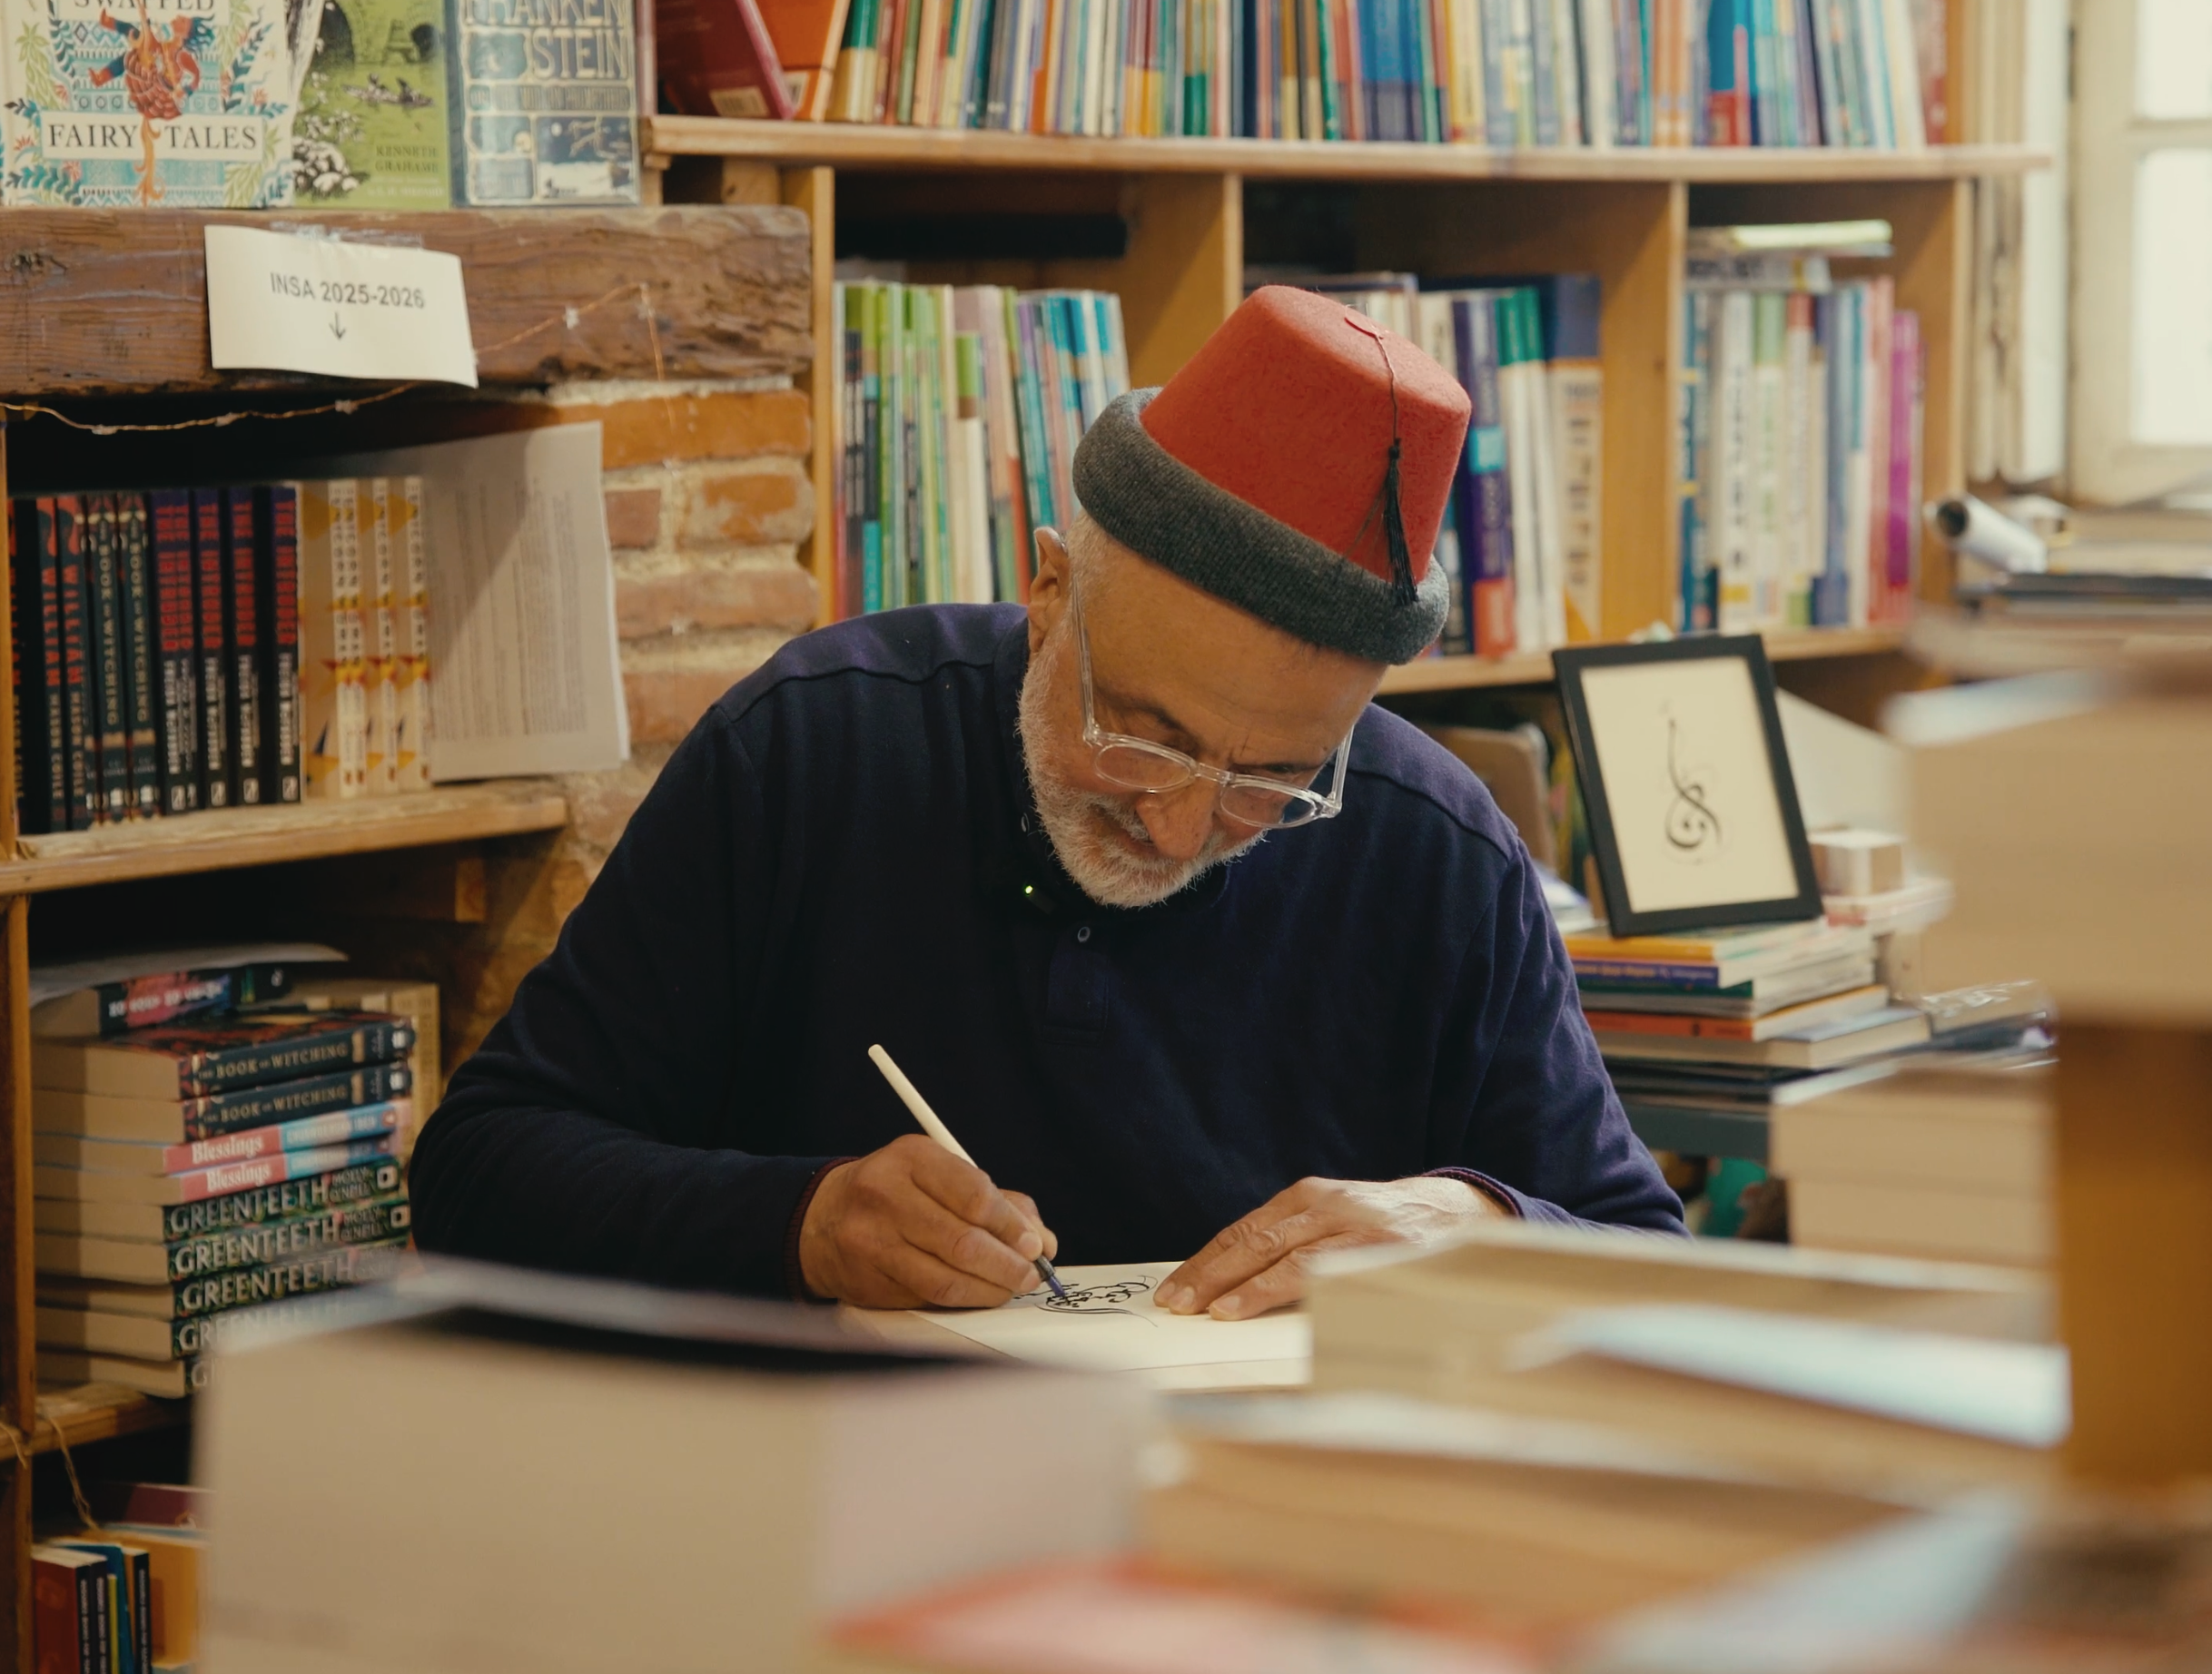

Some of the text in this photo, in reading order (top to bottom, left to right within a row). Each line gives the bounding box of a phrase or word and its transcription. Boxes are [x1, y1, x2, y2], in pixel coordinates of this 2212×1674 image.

[532, 27, 627, 79] STEIN
[48, 124, 257, 150] FAIRY TALES
[375, 145, 439, 157] KENNETH
[374, 161, 439, 173] GRAHAME
[271, 271, 425, 310] INSA 2025-2026
[155, 505, 176, 543] THE
[198, 503, 221, 542] THE
[233, 501, 253, 538] THE
[275, 500, 296, 537] THE
[98, 544, 113, 600] BOOK
[129, 542, 143, 598] BOOK
[233, 547, 257, 646] INTRUDER
[276, 547, 297, 645] INTRUDER
[63, 565, 85, 684] WILLIAM
[158, 551, 180, 652] INTRUDER
[201, 550, 223, 649] INTRUDER
[41, 566, 61, 687] WILLIAM
[104, 619, 119, 725] WITCHING
[133, 617, 150, 722] WITCHING
[216, 1059, 260, 1079] BOOK
[271, 1043, 349, 1069] WITCHING
[221, 1102, 261, 1123] BOOK
[272, 1085, 349, 1111] WITCHING
[192, 1135, 264, 1165] Blessings
[206, 1163, 272, 1193] Blessings
[170, 1181, 328, 1235] GREENTEETH
[174, 1217, 340, 1274] GREENTEETH
[182, 1256, 353, 1310] GREENTEETH
